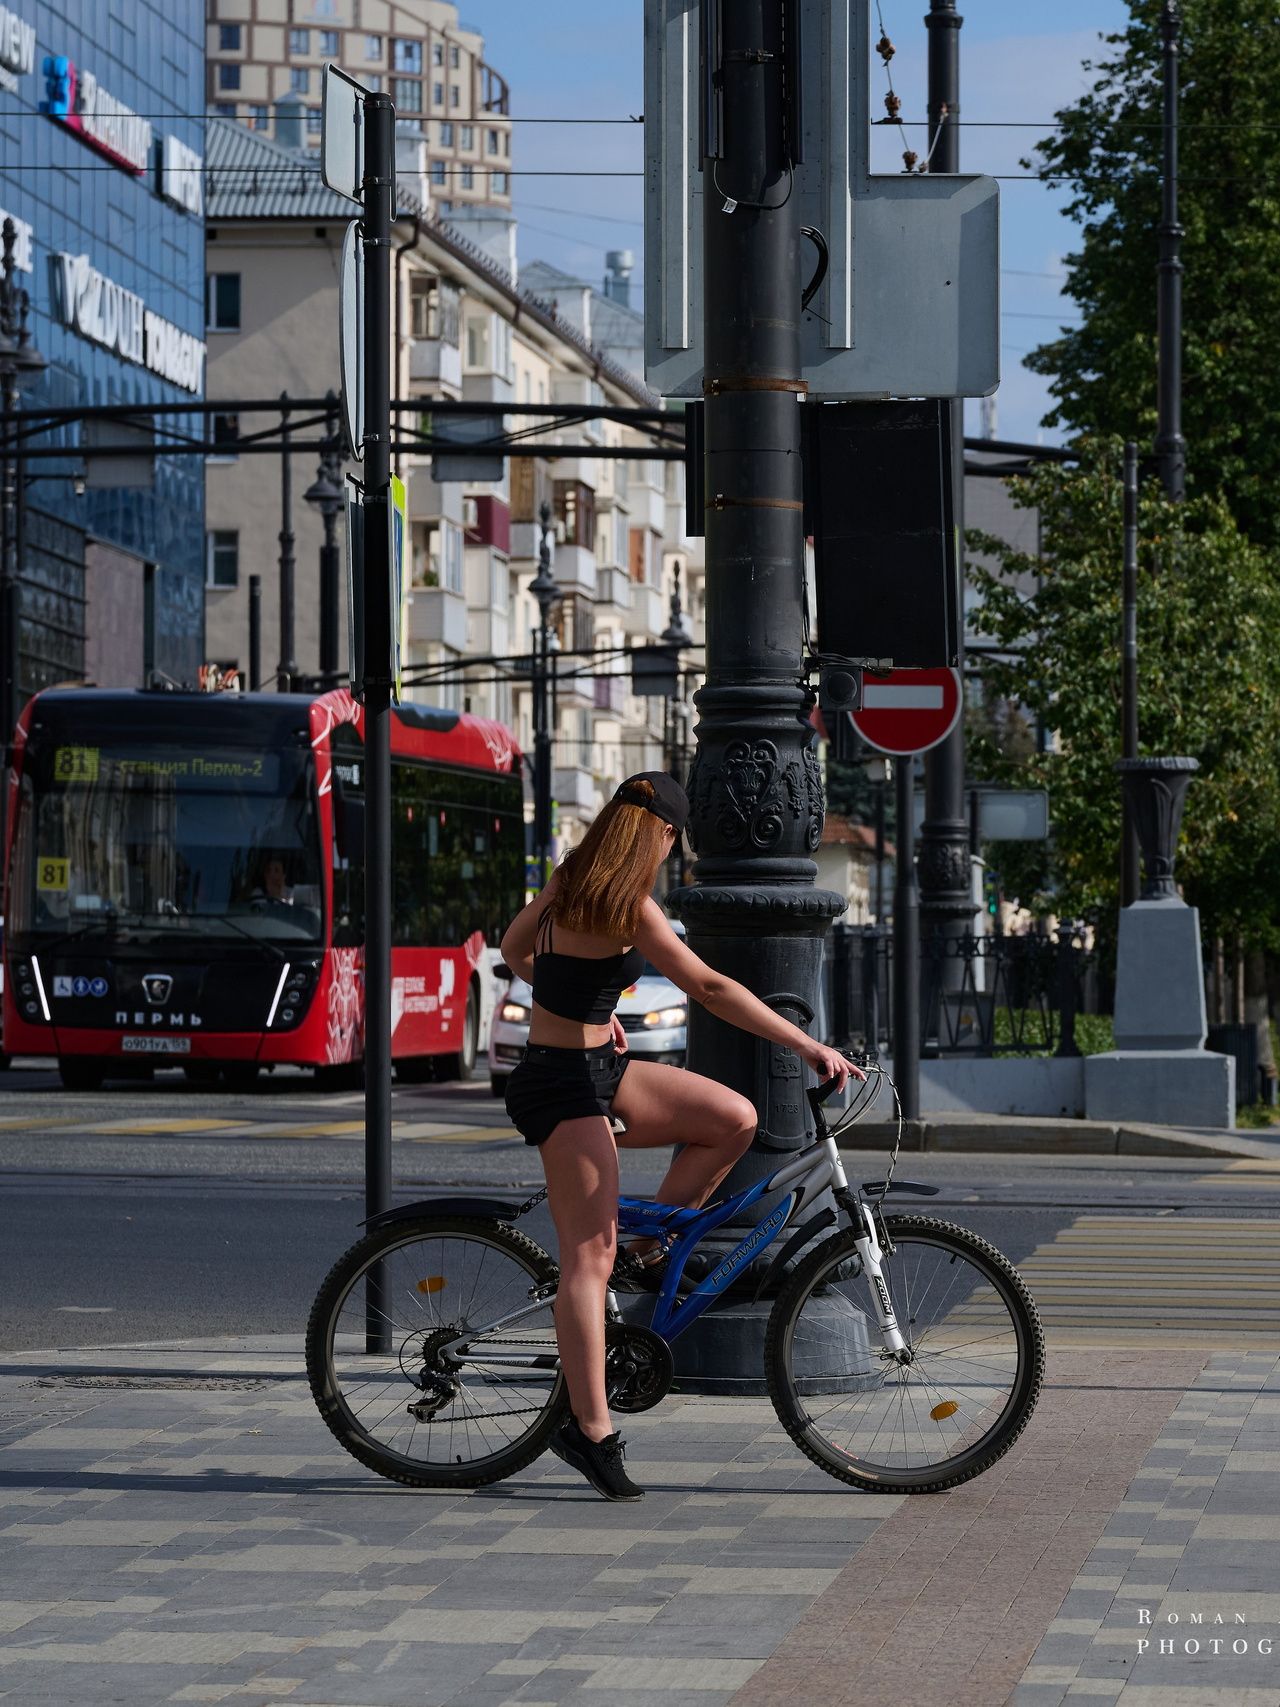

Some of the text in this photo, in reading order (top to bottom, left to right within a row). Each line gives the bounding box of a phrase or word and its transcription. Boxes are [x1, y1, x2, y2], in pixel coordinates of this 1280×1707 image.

[58, 750, 264, 778] 81 станция Пермь-2
[42, 864, 66, 885] 81
[116, 1011, 202, 1027] ПЕРМЬ
[711, 1209, 784, 1286] FORWARD
[875, 1277, 892, 1314] ZOOM
